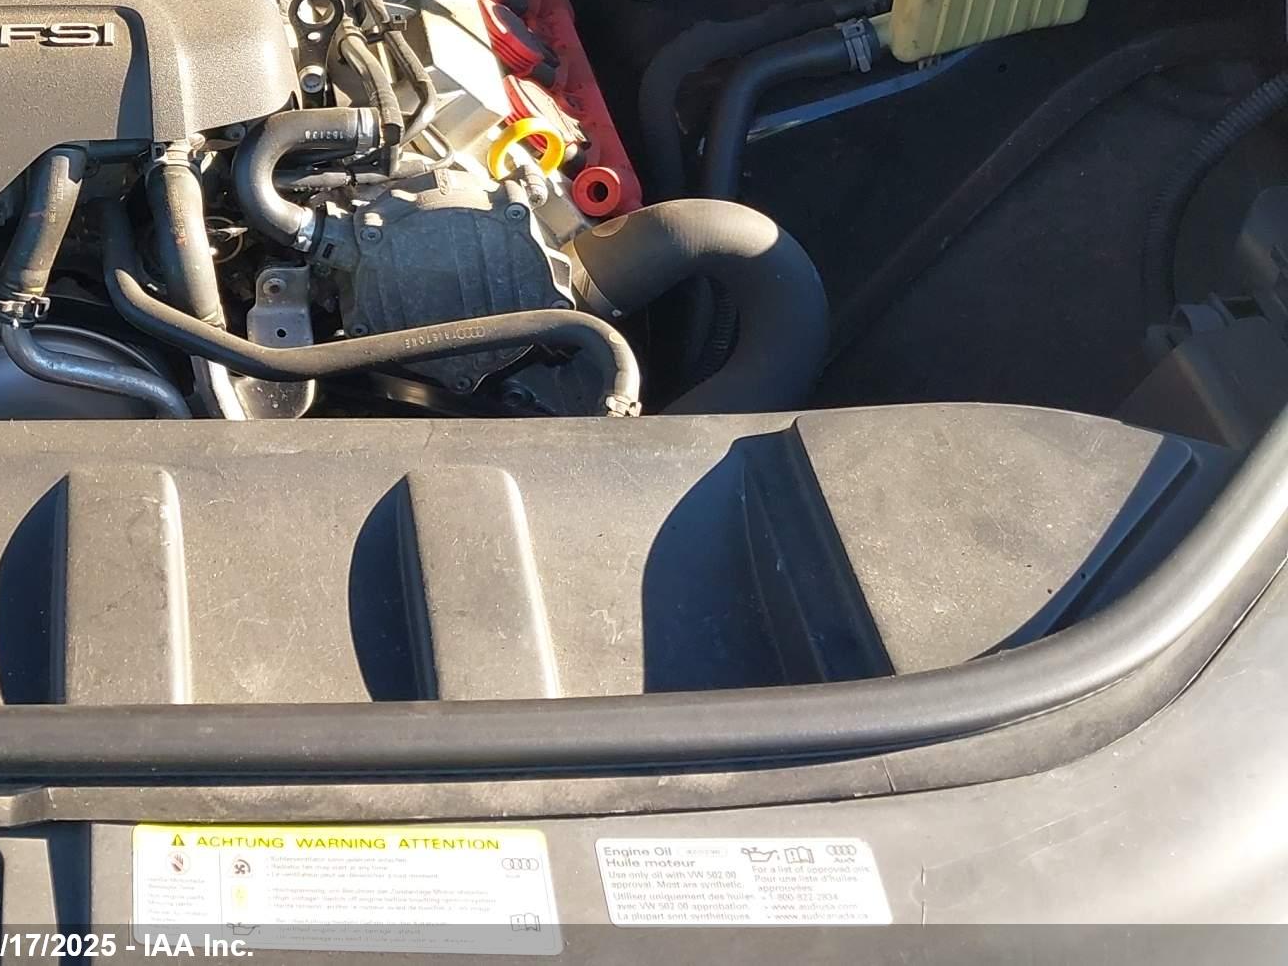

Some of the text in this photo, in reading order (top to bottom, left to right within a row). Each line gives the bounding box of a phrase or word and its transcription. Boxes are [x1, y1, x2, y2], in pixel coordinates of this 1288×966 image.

[197, 836, 499, 850] ACHTUNG WARNING ATTENTION
[603, 846, 651, 858] Engine
[654, 847, 672, 856] Oil
[606, 858, 696, 868] Huile moteur
[608, 870, 627, 879] Use
[629, 870, 649, 881] only
[653, 871, 663, 879] oil
[665, 871, 685, 879] with
[687, 871, 704, 879] VW
[706, 871, 723, 879] 502
[657, 881, 680, 889] Most
[639, 902, 656, 910] VW
[658, 902, 674, 910] 502
[617, 912, 628, 920] La
